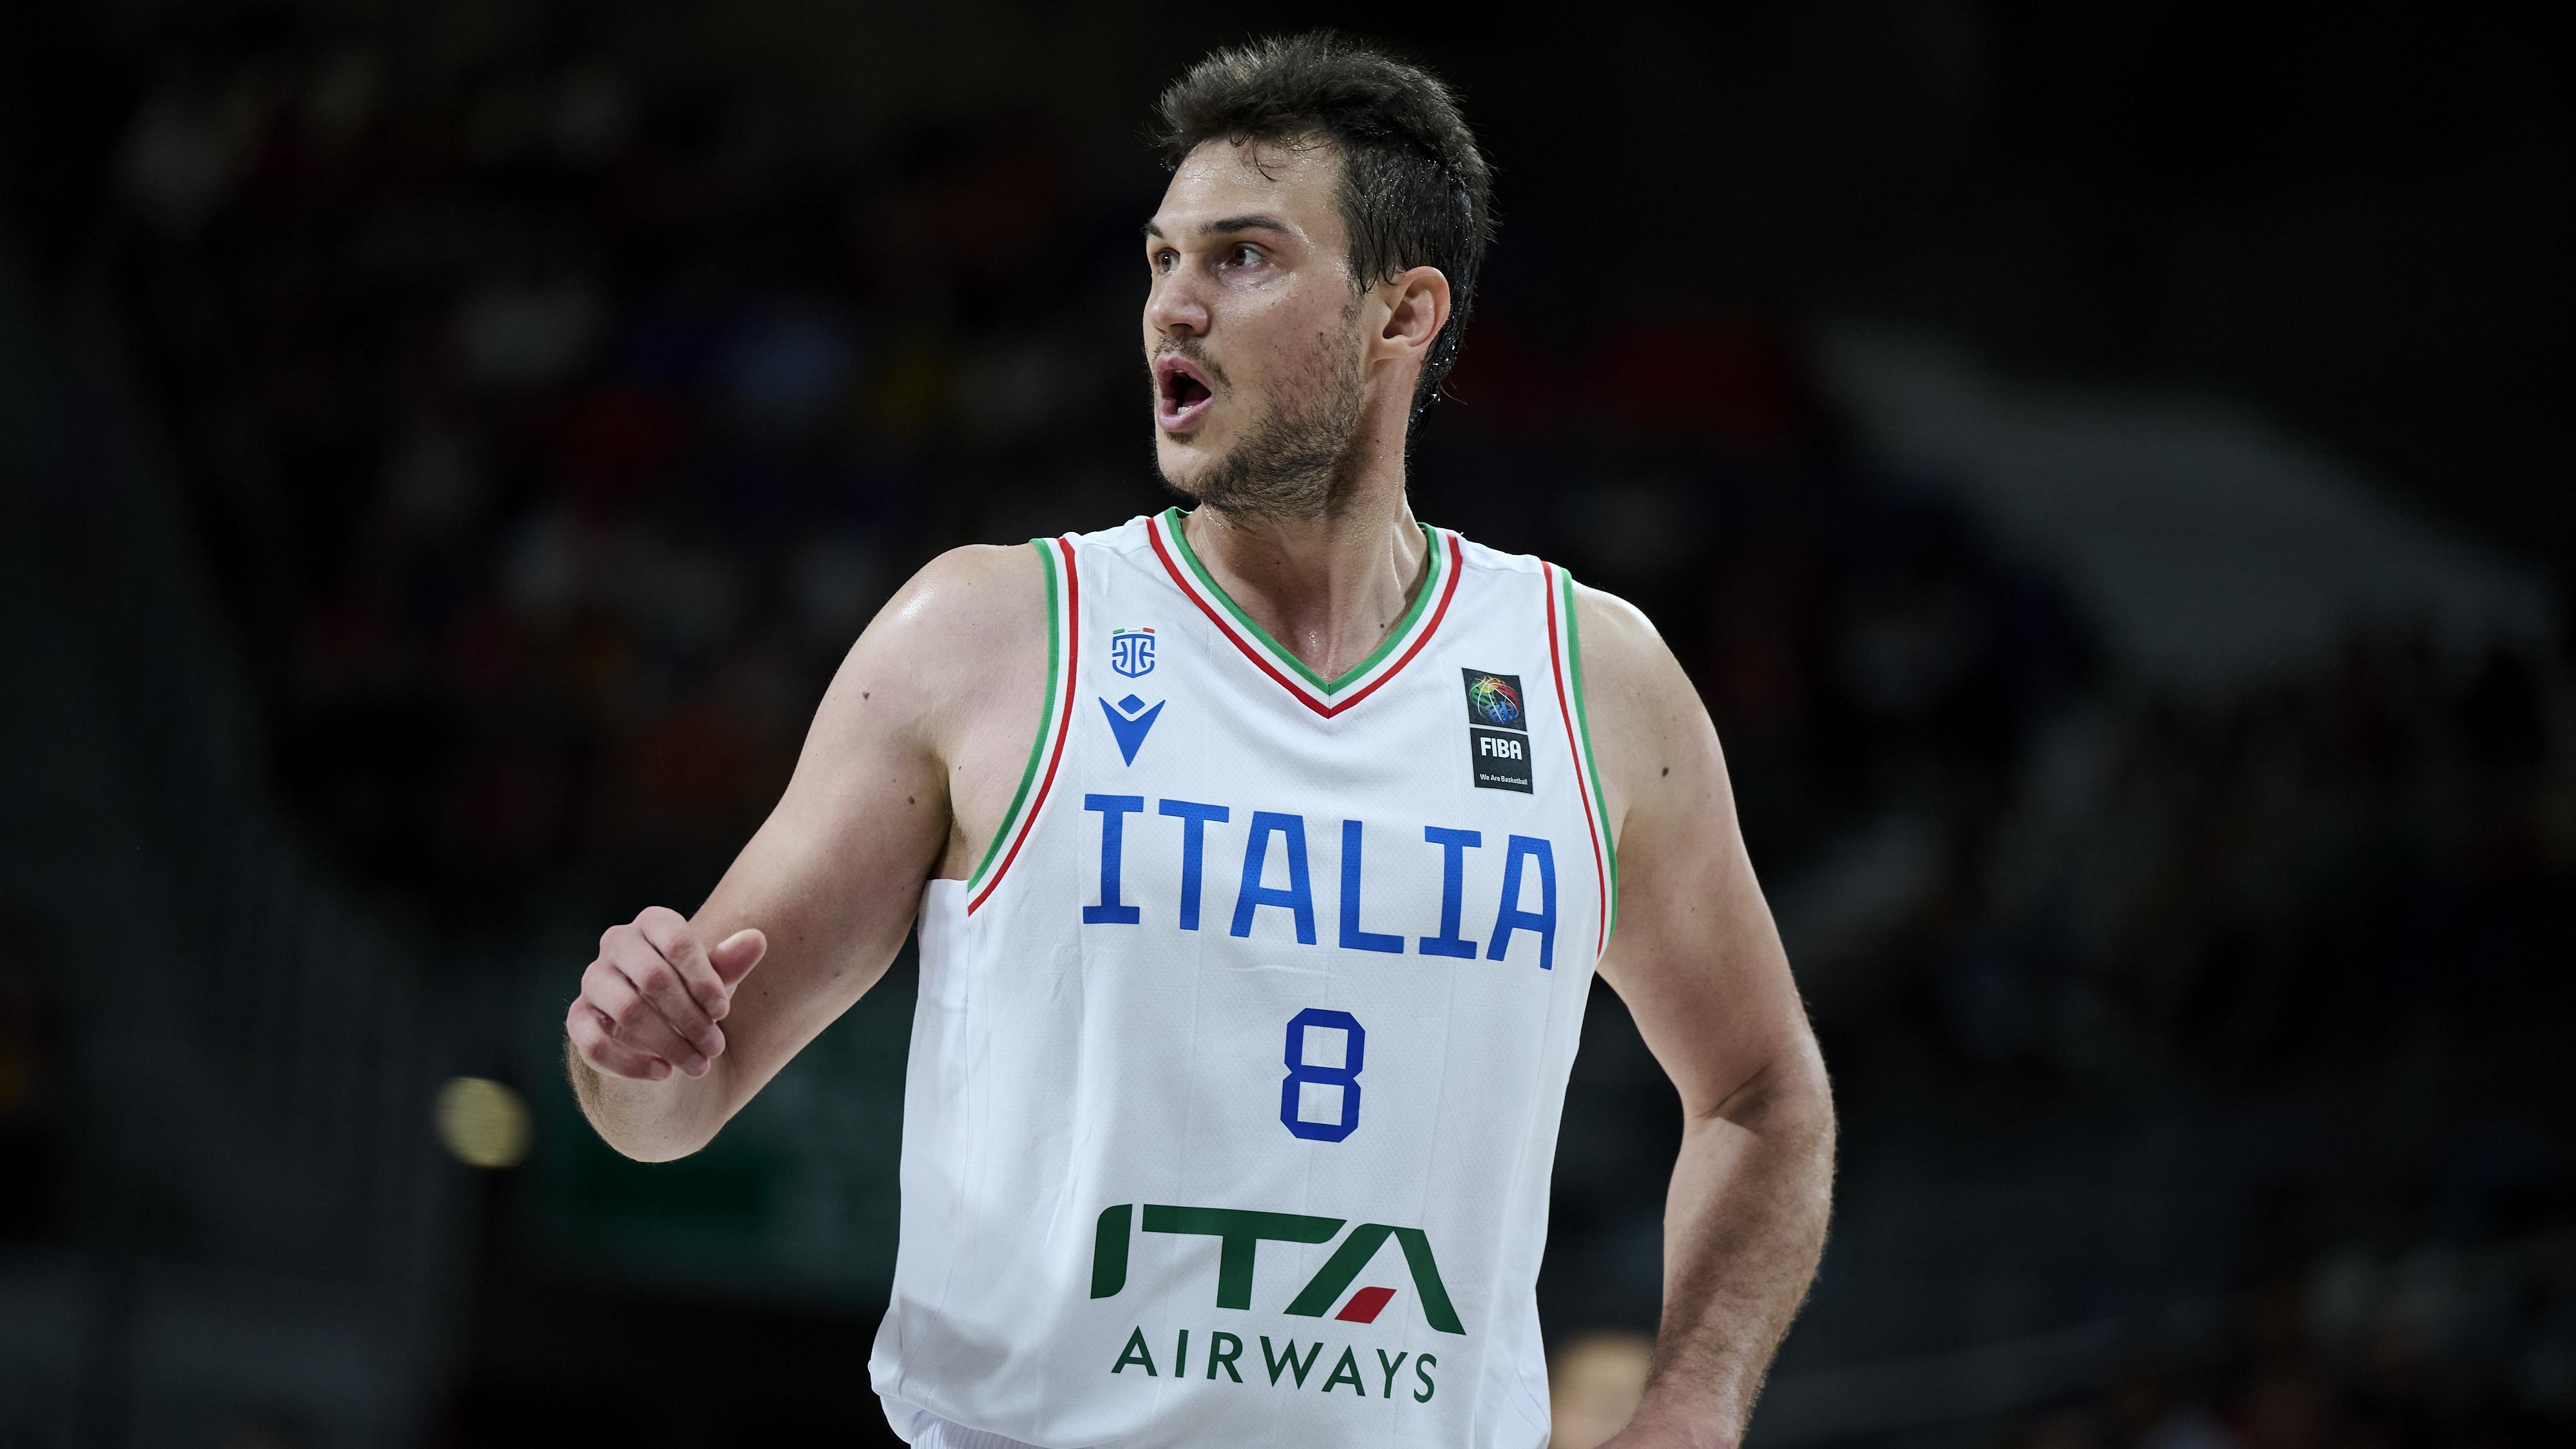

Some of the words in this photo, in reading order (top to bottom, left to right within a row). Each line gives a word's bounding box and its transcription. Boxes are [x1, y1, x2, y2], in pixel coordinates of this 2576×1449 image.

[1480, 737, 1522, 760] FIBA
[1501, 776, 1528, 785] Basketball
[1083, 793, 1557, 971] ITALIA
[1280, 1007, 1366, 1143] 8
[1090, 1203, 1466, 1336] ITA
[1111, 1325, 1437, 1403] AIRWAYS
